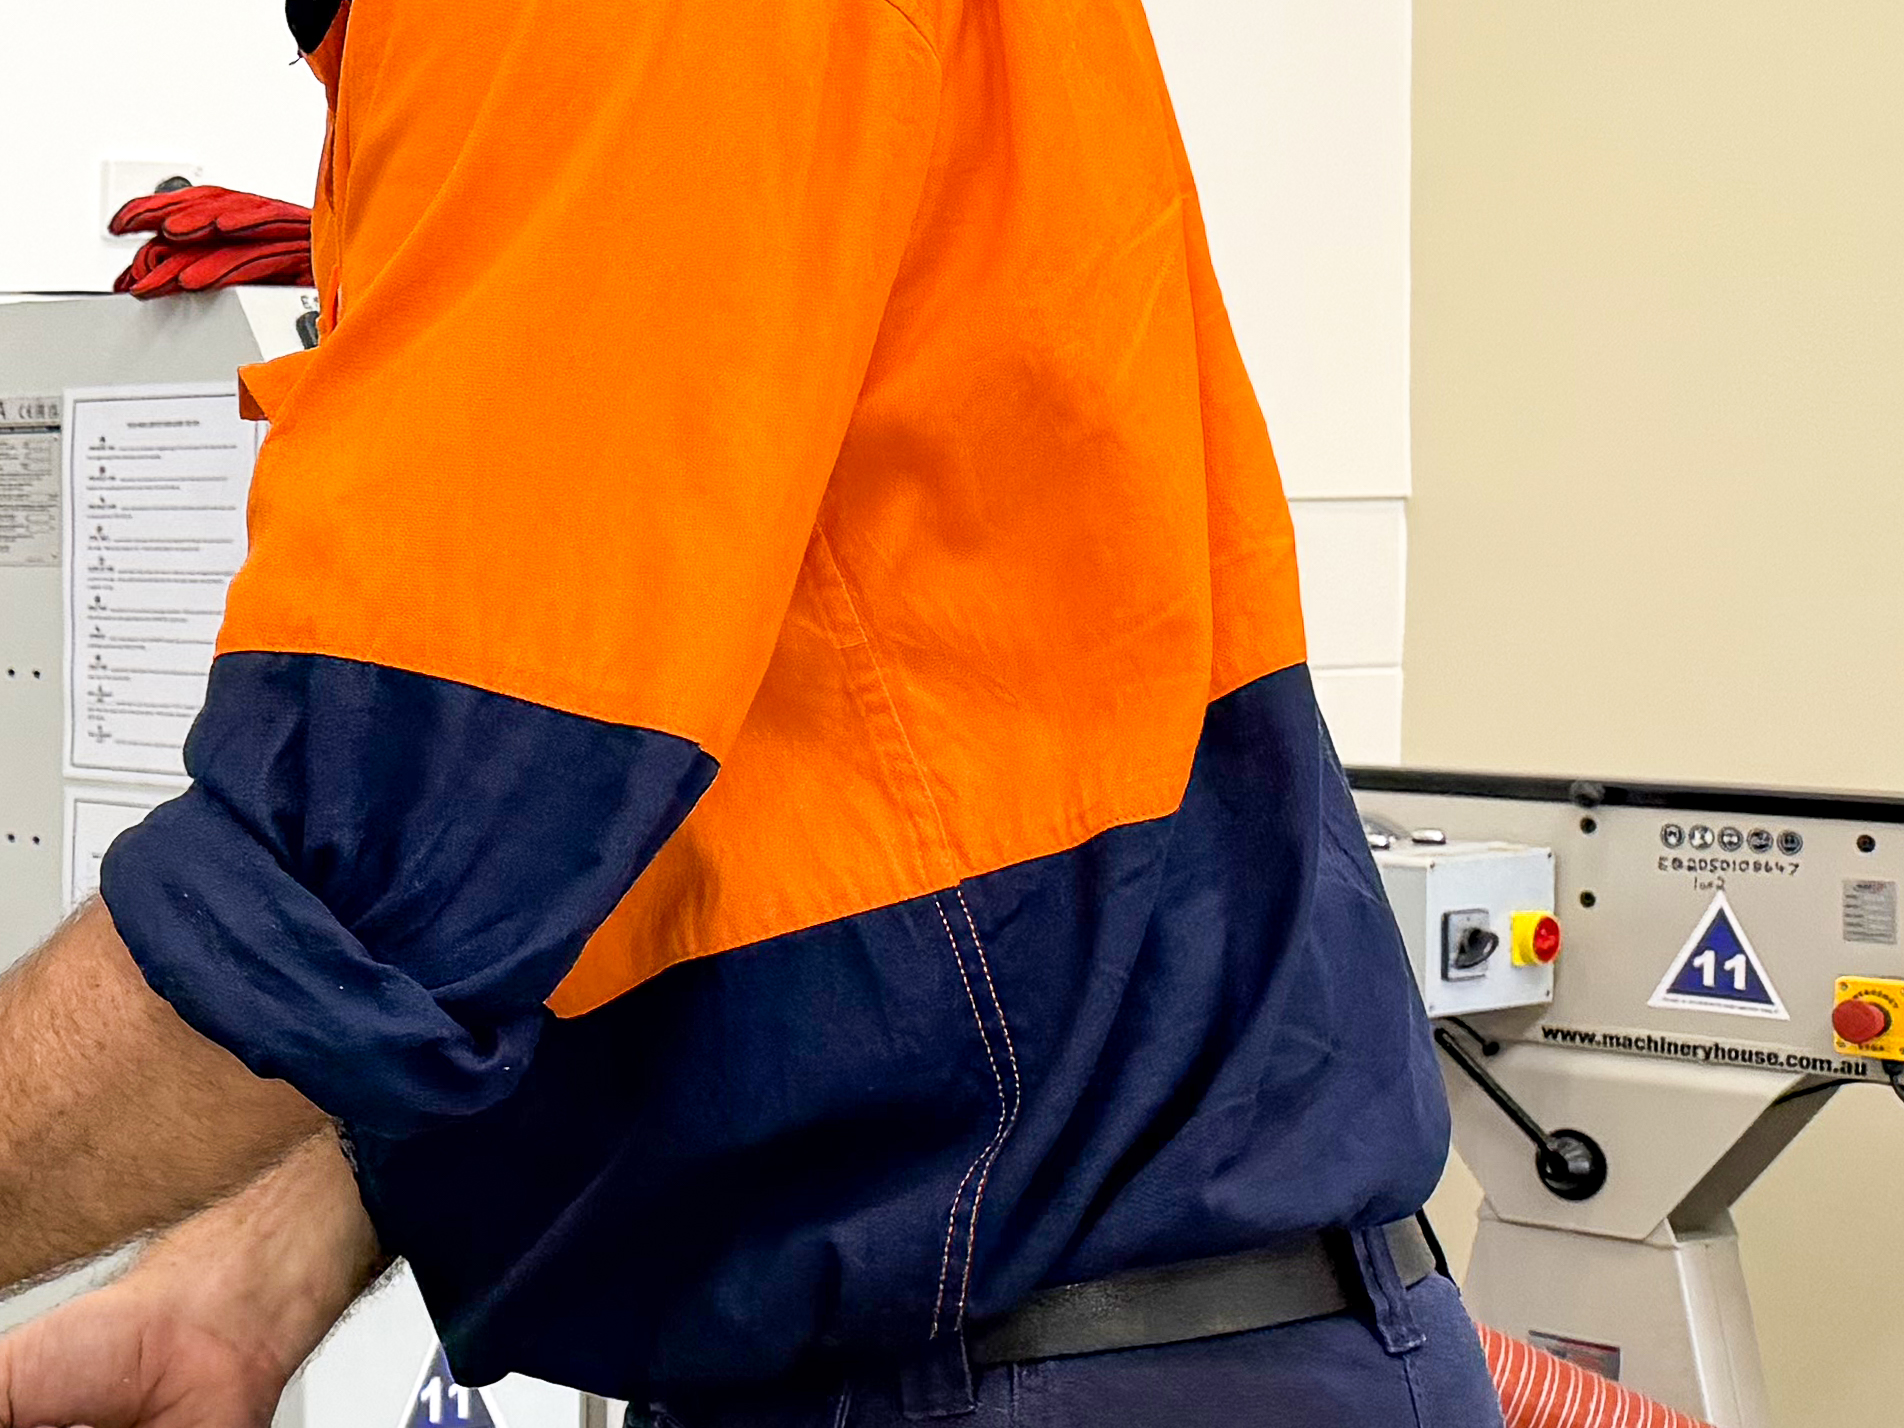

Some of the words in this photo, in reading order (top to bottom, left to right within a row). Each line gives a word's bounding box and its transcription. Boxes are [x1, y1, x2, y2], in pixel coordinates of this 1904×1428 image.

[1693, 949, 1747, 991] 11
[1541, 1024, 1868, 1077] www.machineryhouse.com.au
[420, 1376, 469, 1424] 11
